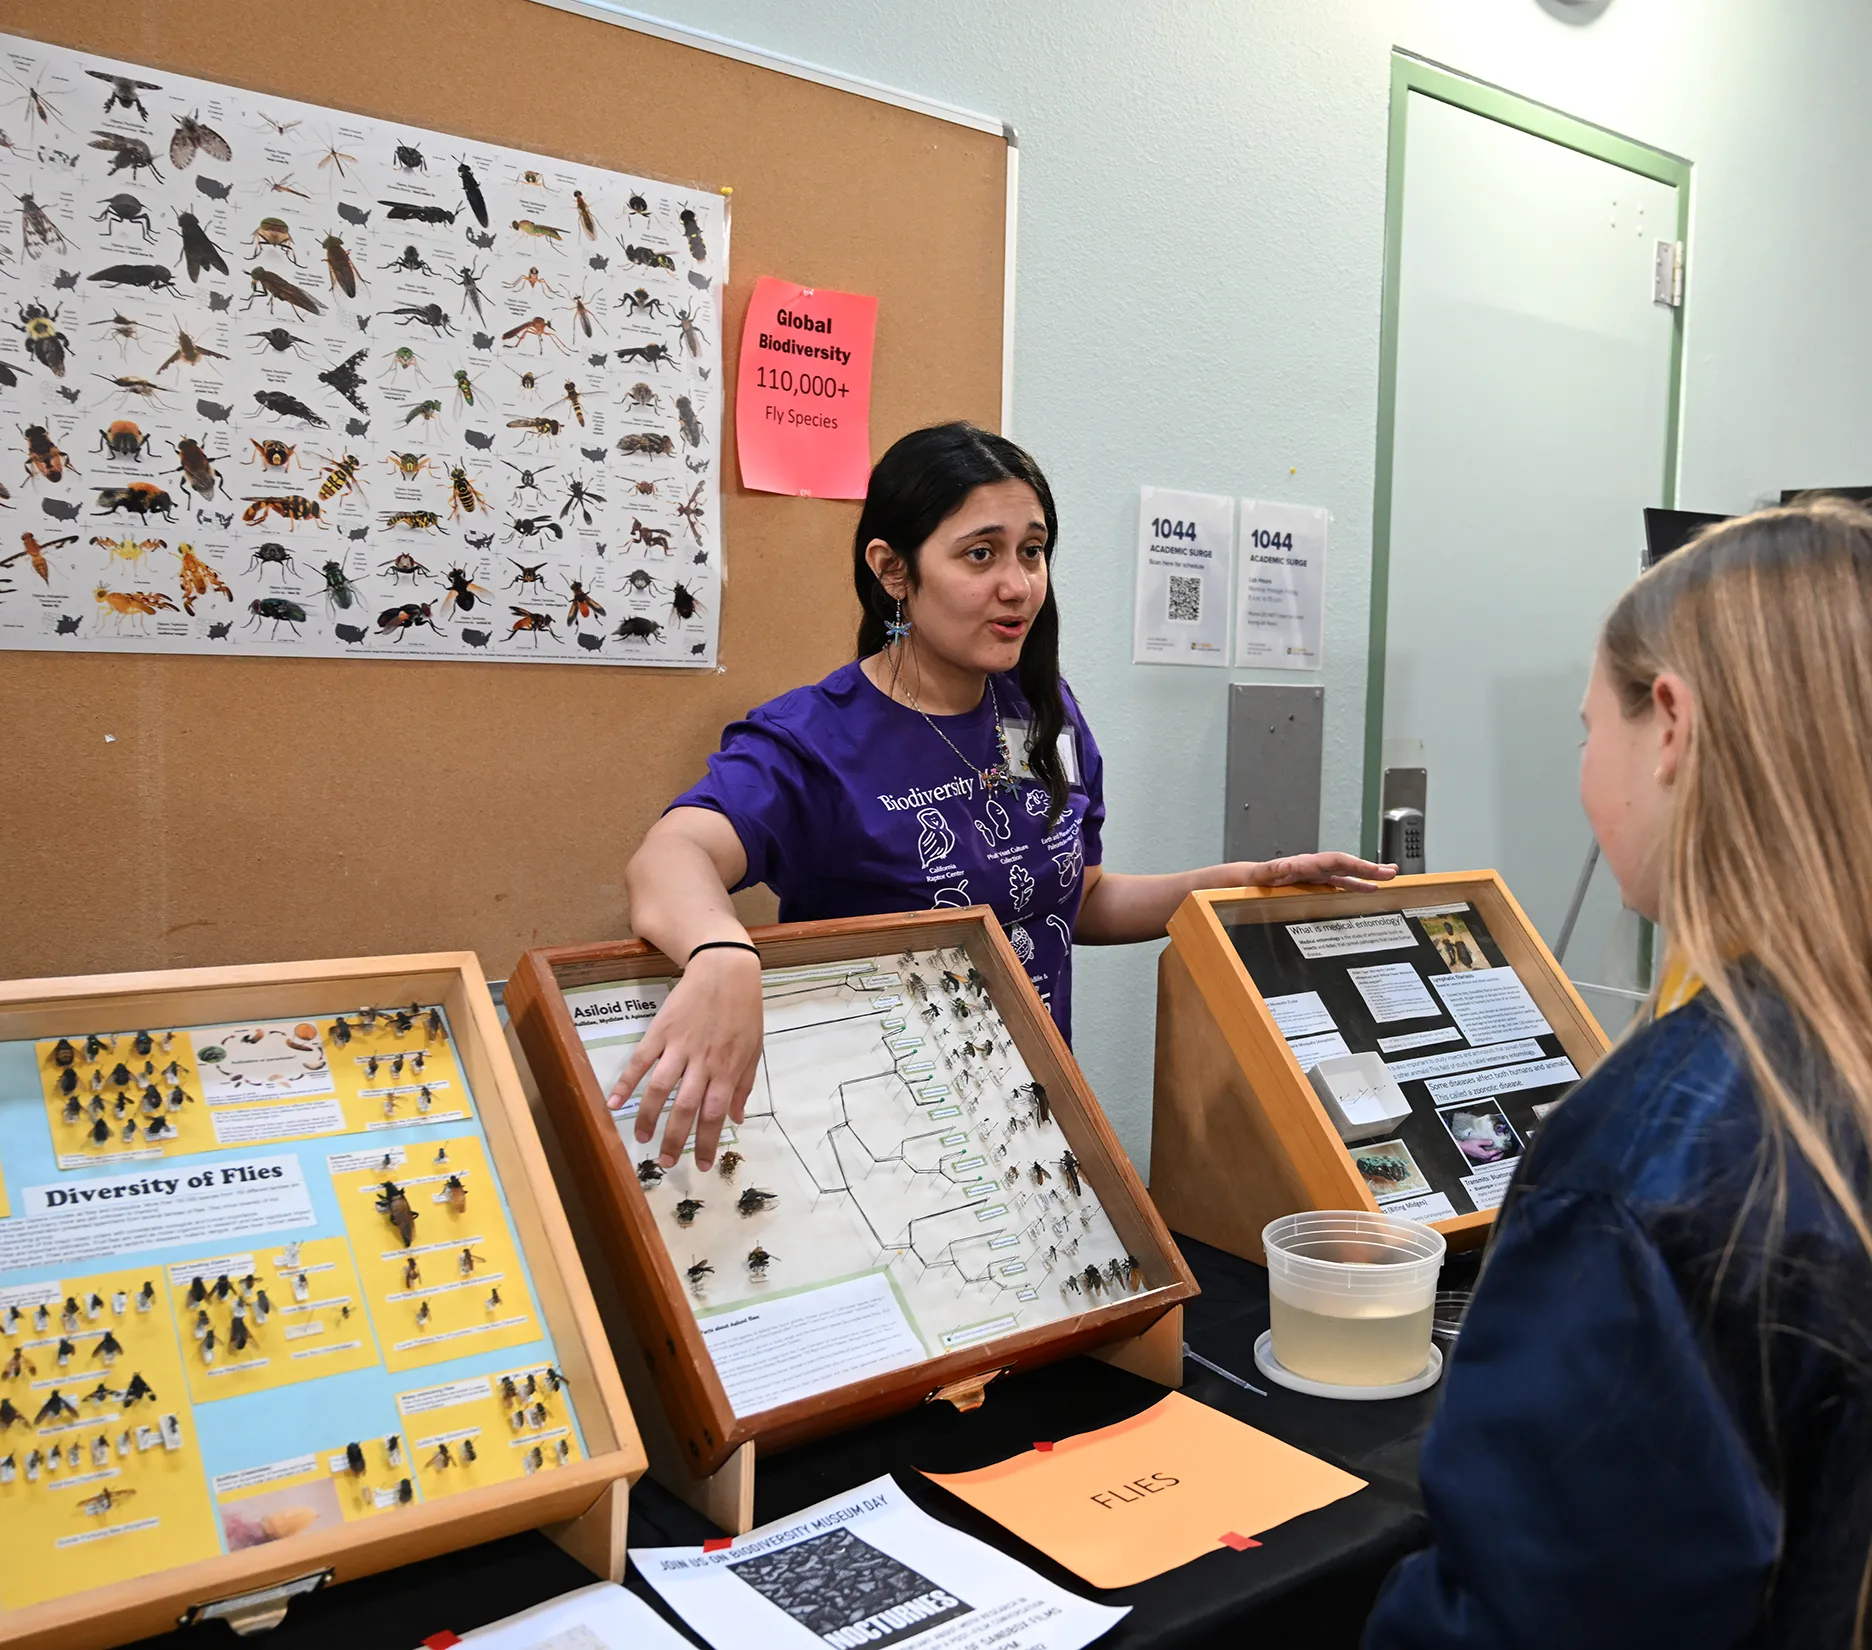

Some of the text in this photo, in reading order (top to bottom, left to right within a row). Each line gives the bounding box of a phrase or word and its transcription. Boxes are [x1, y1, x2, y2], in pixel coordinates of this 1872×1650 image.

[777, 309, 832, 334] Global
[759, 333, 851, 365] Biodiversity
[757, 366, 850, 398] 110,000+
[765, 405, 838, 429] Fly Species
[1151, 517, 1197, 542] 1044
[1251, 529, 1293, 551] 1044
[1150, 544, 1213, 559] ACADEMIC SURGE
[1250, 555, 1308, 567] ACADEMIC SURGE
[877, 776, 974, 811] Biodiversity
[926, 869, 965, 883] Raptor Center
[928, 863, 956, 874] California
[1289, 925, 1313, 934] What
[1320, 920, 1355, 931] medical
[1353, 915, 1406, 929] entomology?
[574, 998, 657, 1018] Asiloid Flies
[1427, 1080, 1449, 1090] Some
[1447, 1076, 1476, 1087] diseases
[1474, 1072, 1495, 1082] affect
[1493, 1070, 1510, 1079] both
[1508, 1065, 1534, 1076] humans
[1531, 1063, 1546, 1072] and
[1433, 1092, 1449, 1101] This
[1447, 1089, 1467, 1098] called
[1471, 1083, 1499, 1094] zoonotic
[45, 1164, 284, 1208] Diversity of Flies
[1387, 1199, 1428, 1214] (Biting Midges)
[1090, 1472, 1180, 1509] FLIES
[660, 1494, 889, 1572] JOIN US ON BIODIVERSITY MUSEUM DAY
[822, 1589, 961, 1650] NOCTURNES
